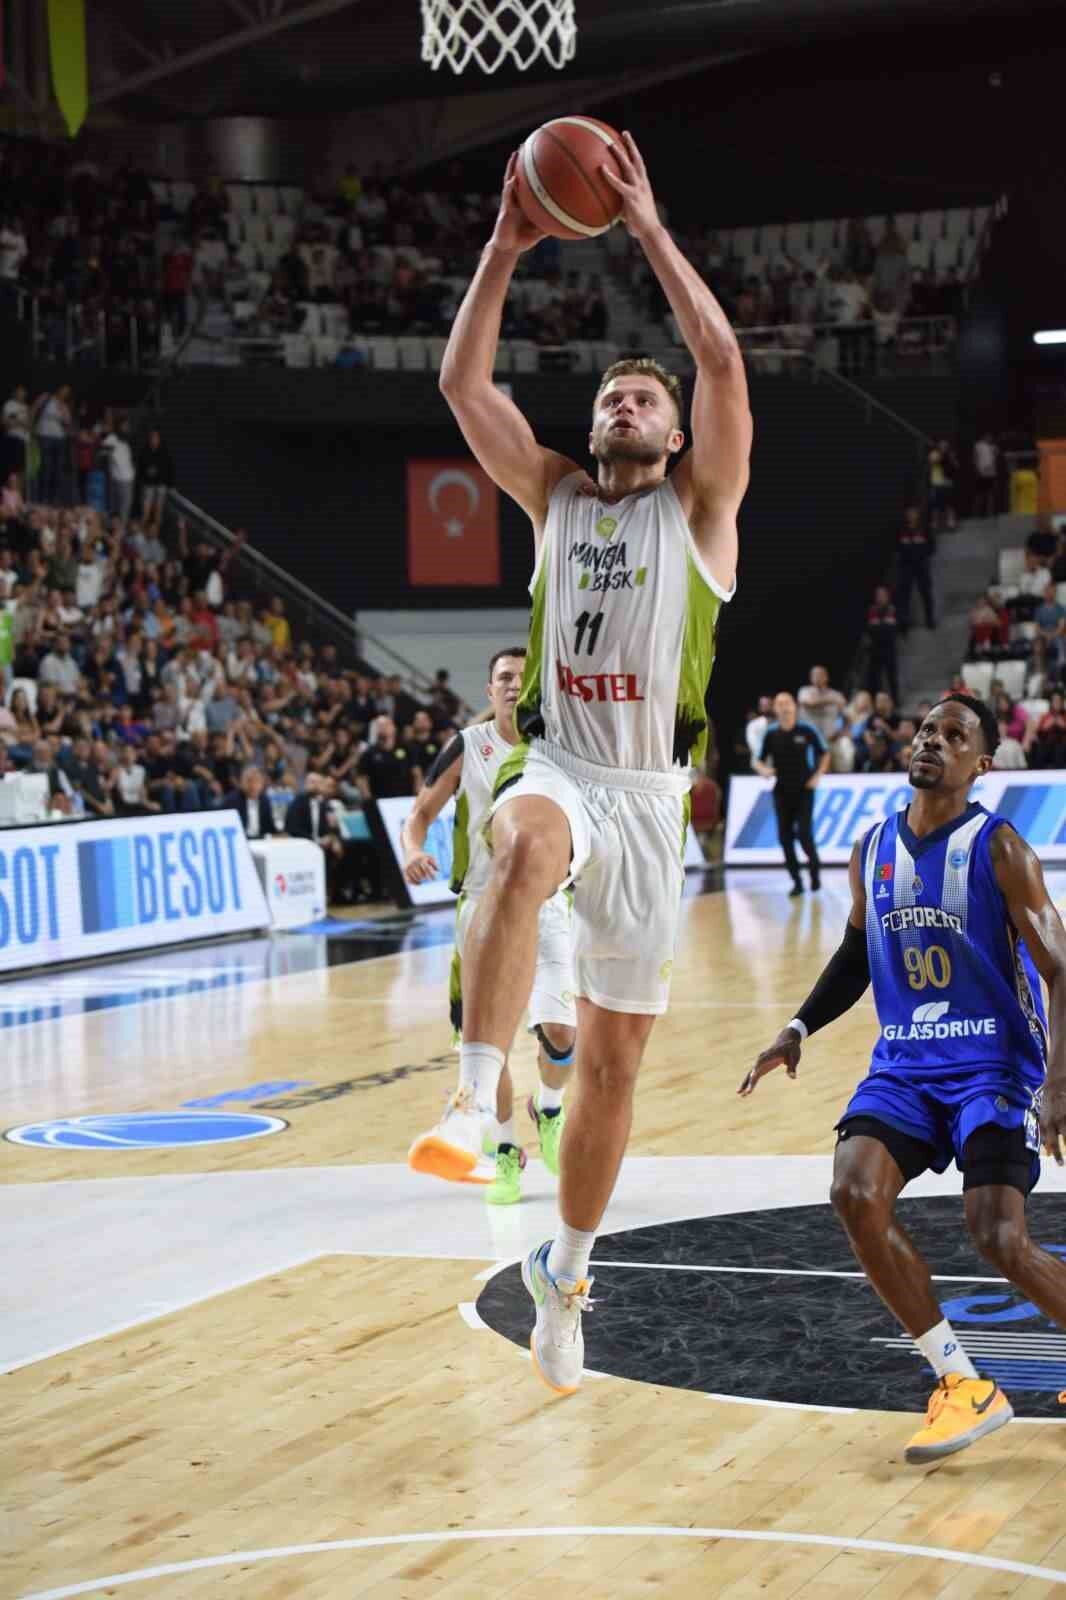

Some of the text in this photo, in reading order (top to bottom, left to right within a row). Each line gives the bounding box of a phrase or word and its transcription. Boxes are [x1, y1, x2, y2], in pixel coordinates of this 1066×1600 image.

[574, 610, 605, 656] 11
[133, 826, 242, 925] BESOT
[903, 945, 951, 991] 90
